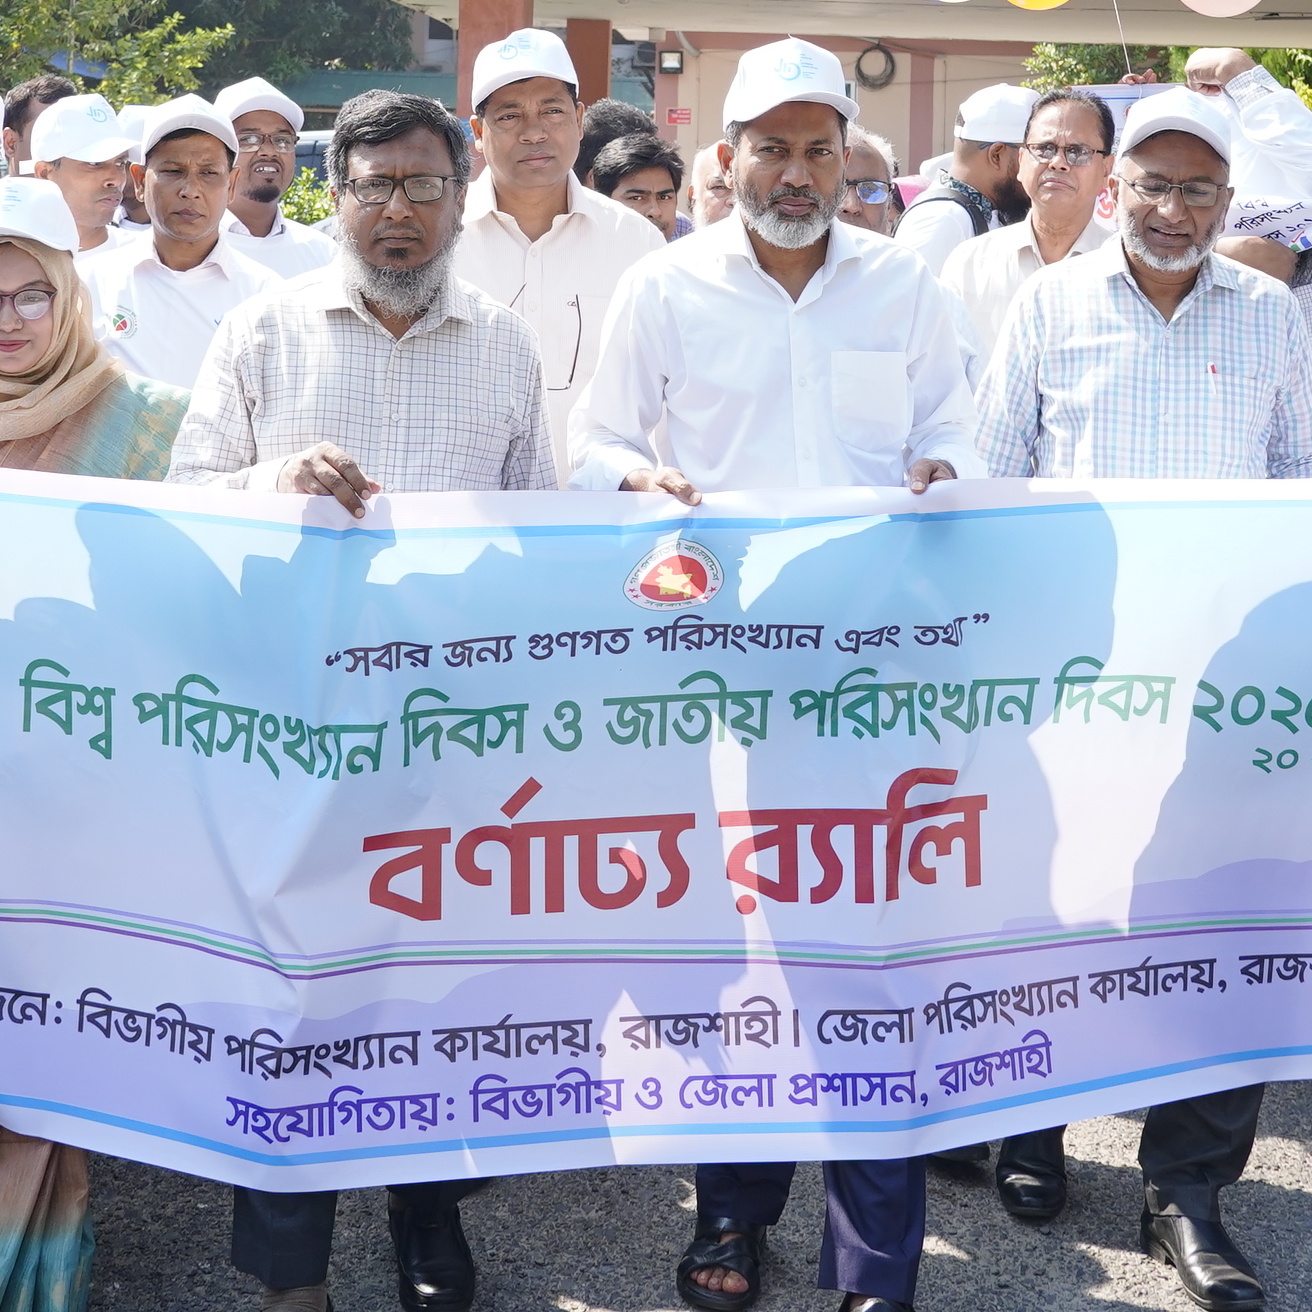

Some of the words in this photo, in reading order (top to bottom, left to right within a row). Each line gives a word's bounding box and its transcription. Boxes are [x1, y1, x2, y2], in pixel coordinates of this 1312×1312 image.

[442, 635, 517, 668] জন্য
[527, 628, 634, 661] গুণগত
[643, 614, 824, 654] পরিসংখ্যান
[834, 625, 901, 654] এবং
[19, 658, 116, 760] বিশ্ব
[132, 673, 389, 781] পরিসংখ্যান
[400, 687, 529, 768] দিবস
[542, 700, 583, 752] ও
[603, 670, 773, 749] জাতীয়
[788, 666, 1040, 745] পরিসংখ্যান
[1053, 655, 1177, 725] দিবস
[1252, 748, 1299, 774] ২০
[362, 776, 696, 922] বর্ণাঢ্য
[76, 987, 215, 1064] বিভাগীয়
[223, 1027, 421, 1081] পরিসংখ্যান
[432, 1013, 607, 1063] কার্যালয়,
[817, 1007, 915, 1046] জেলা
[922, 981, 1079, 1035] পরিসংখ্যান
[1088, 956, 1227, 1005] কার্যালয়,
[469, 1066, 624, 1123] বিভাগীয়
[634, 1076, 663, 1111] ও
[679, 1073, 777, 1110] জেলা
[788, 1069, 928, 1108] প্রশাসন,
[935, 1029, 1052, 1097] রাজশাহী
